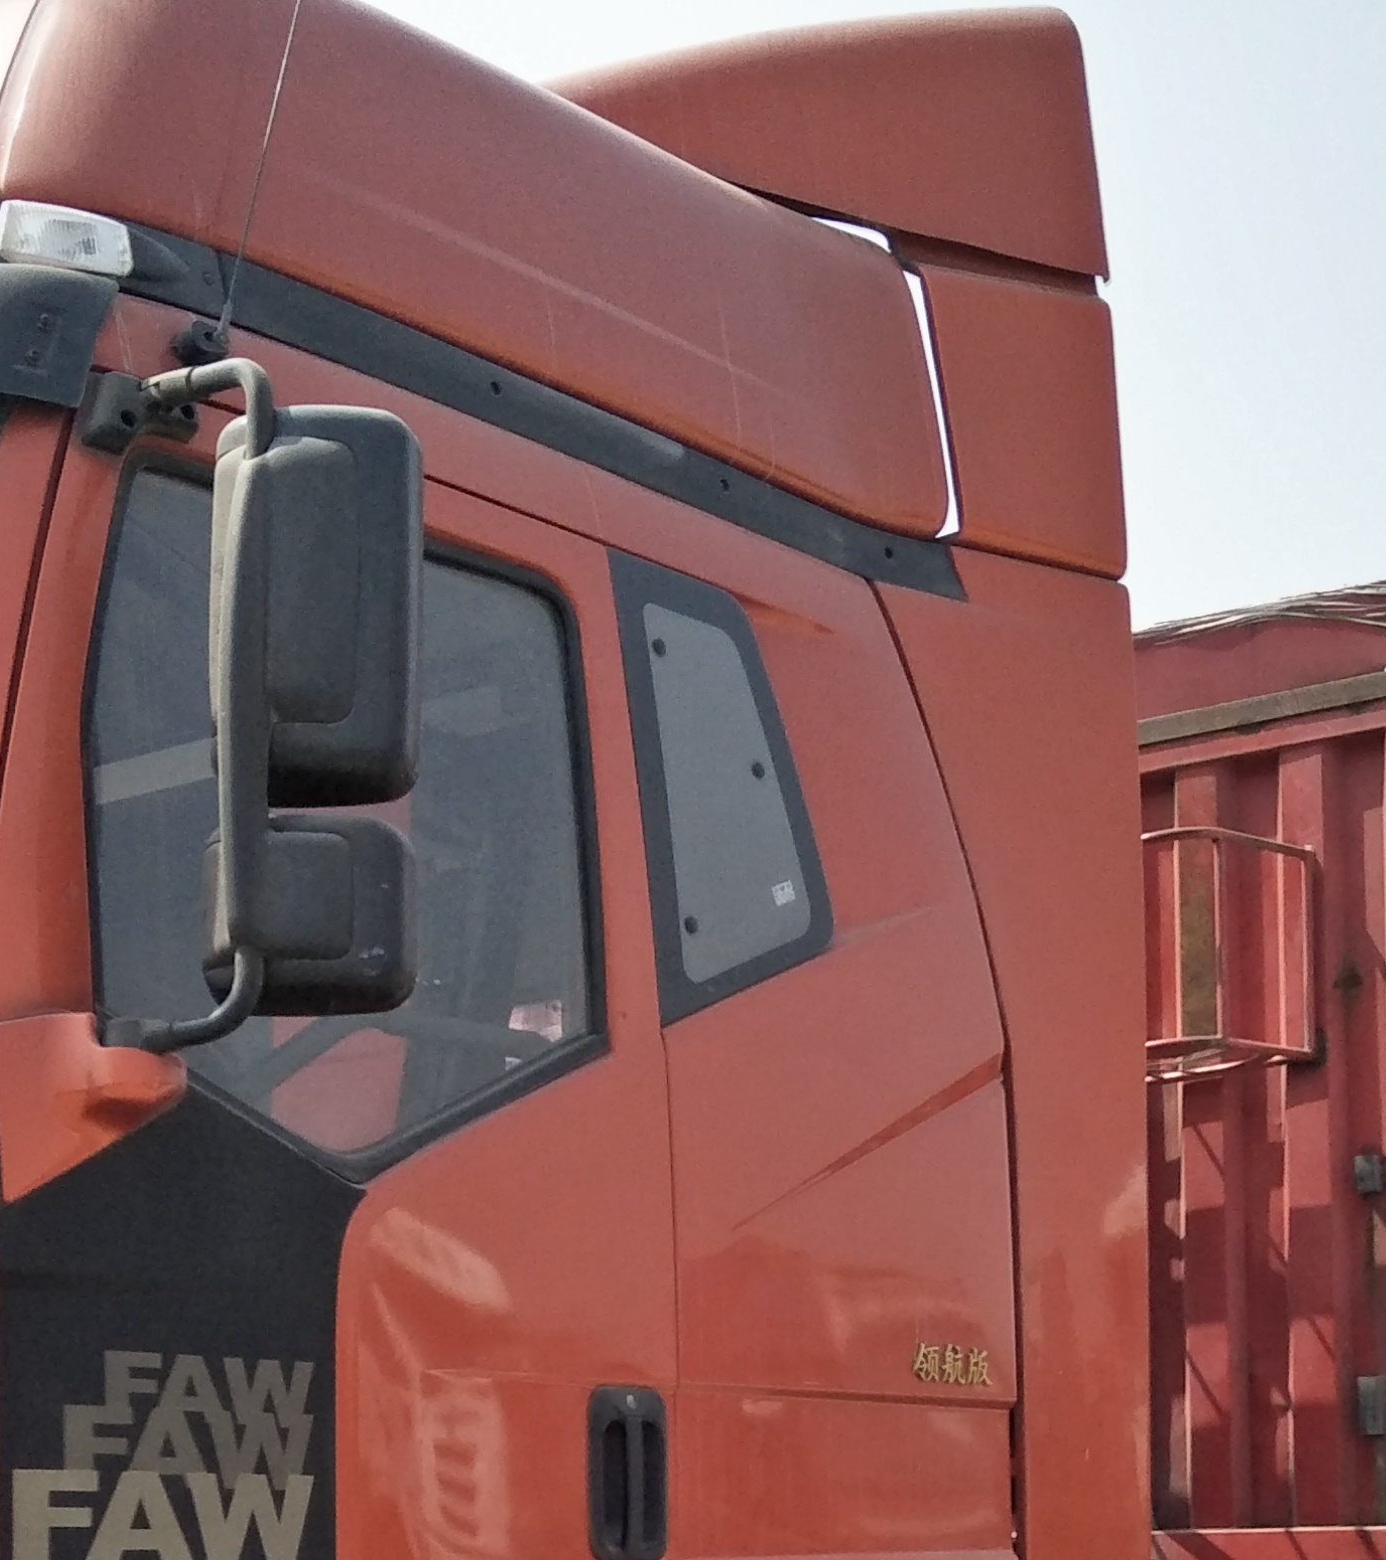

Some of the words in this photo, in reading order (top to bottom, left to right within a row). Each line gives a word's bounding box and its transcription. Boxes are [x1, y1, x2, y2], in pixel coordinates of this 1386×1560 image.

[104, 1349, 314, 1424] FAW
[913, 1342, 994, 1387] 领航版
[63, 1404, 314, 1490] FAW
